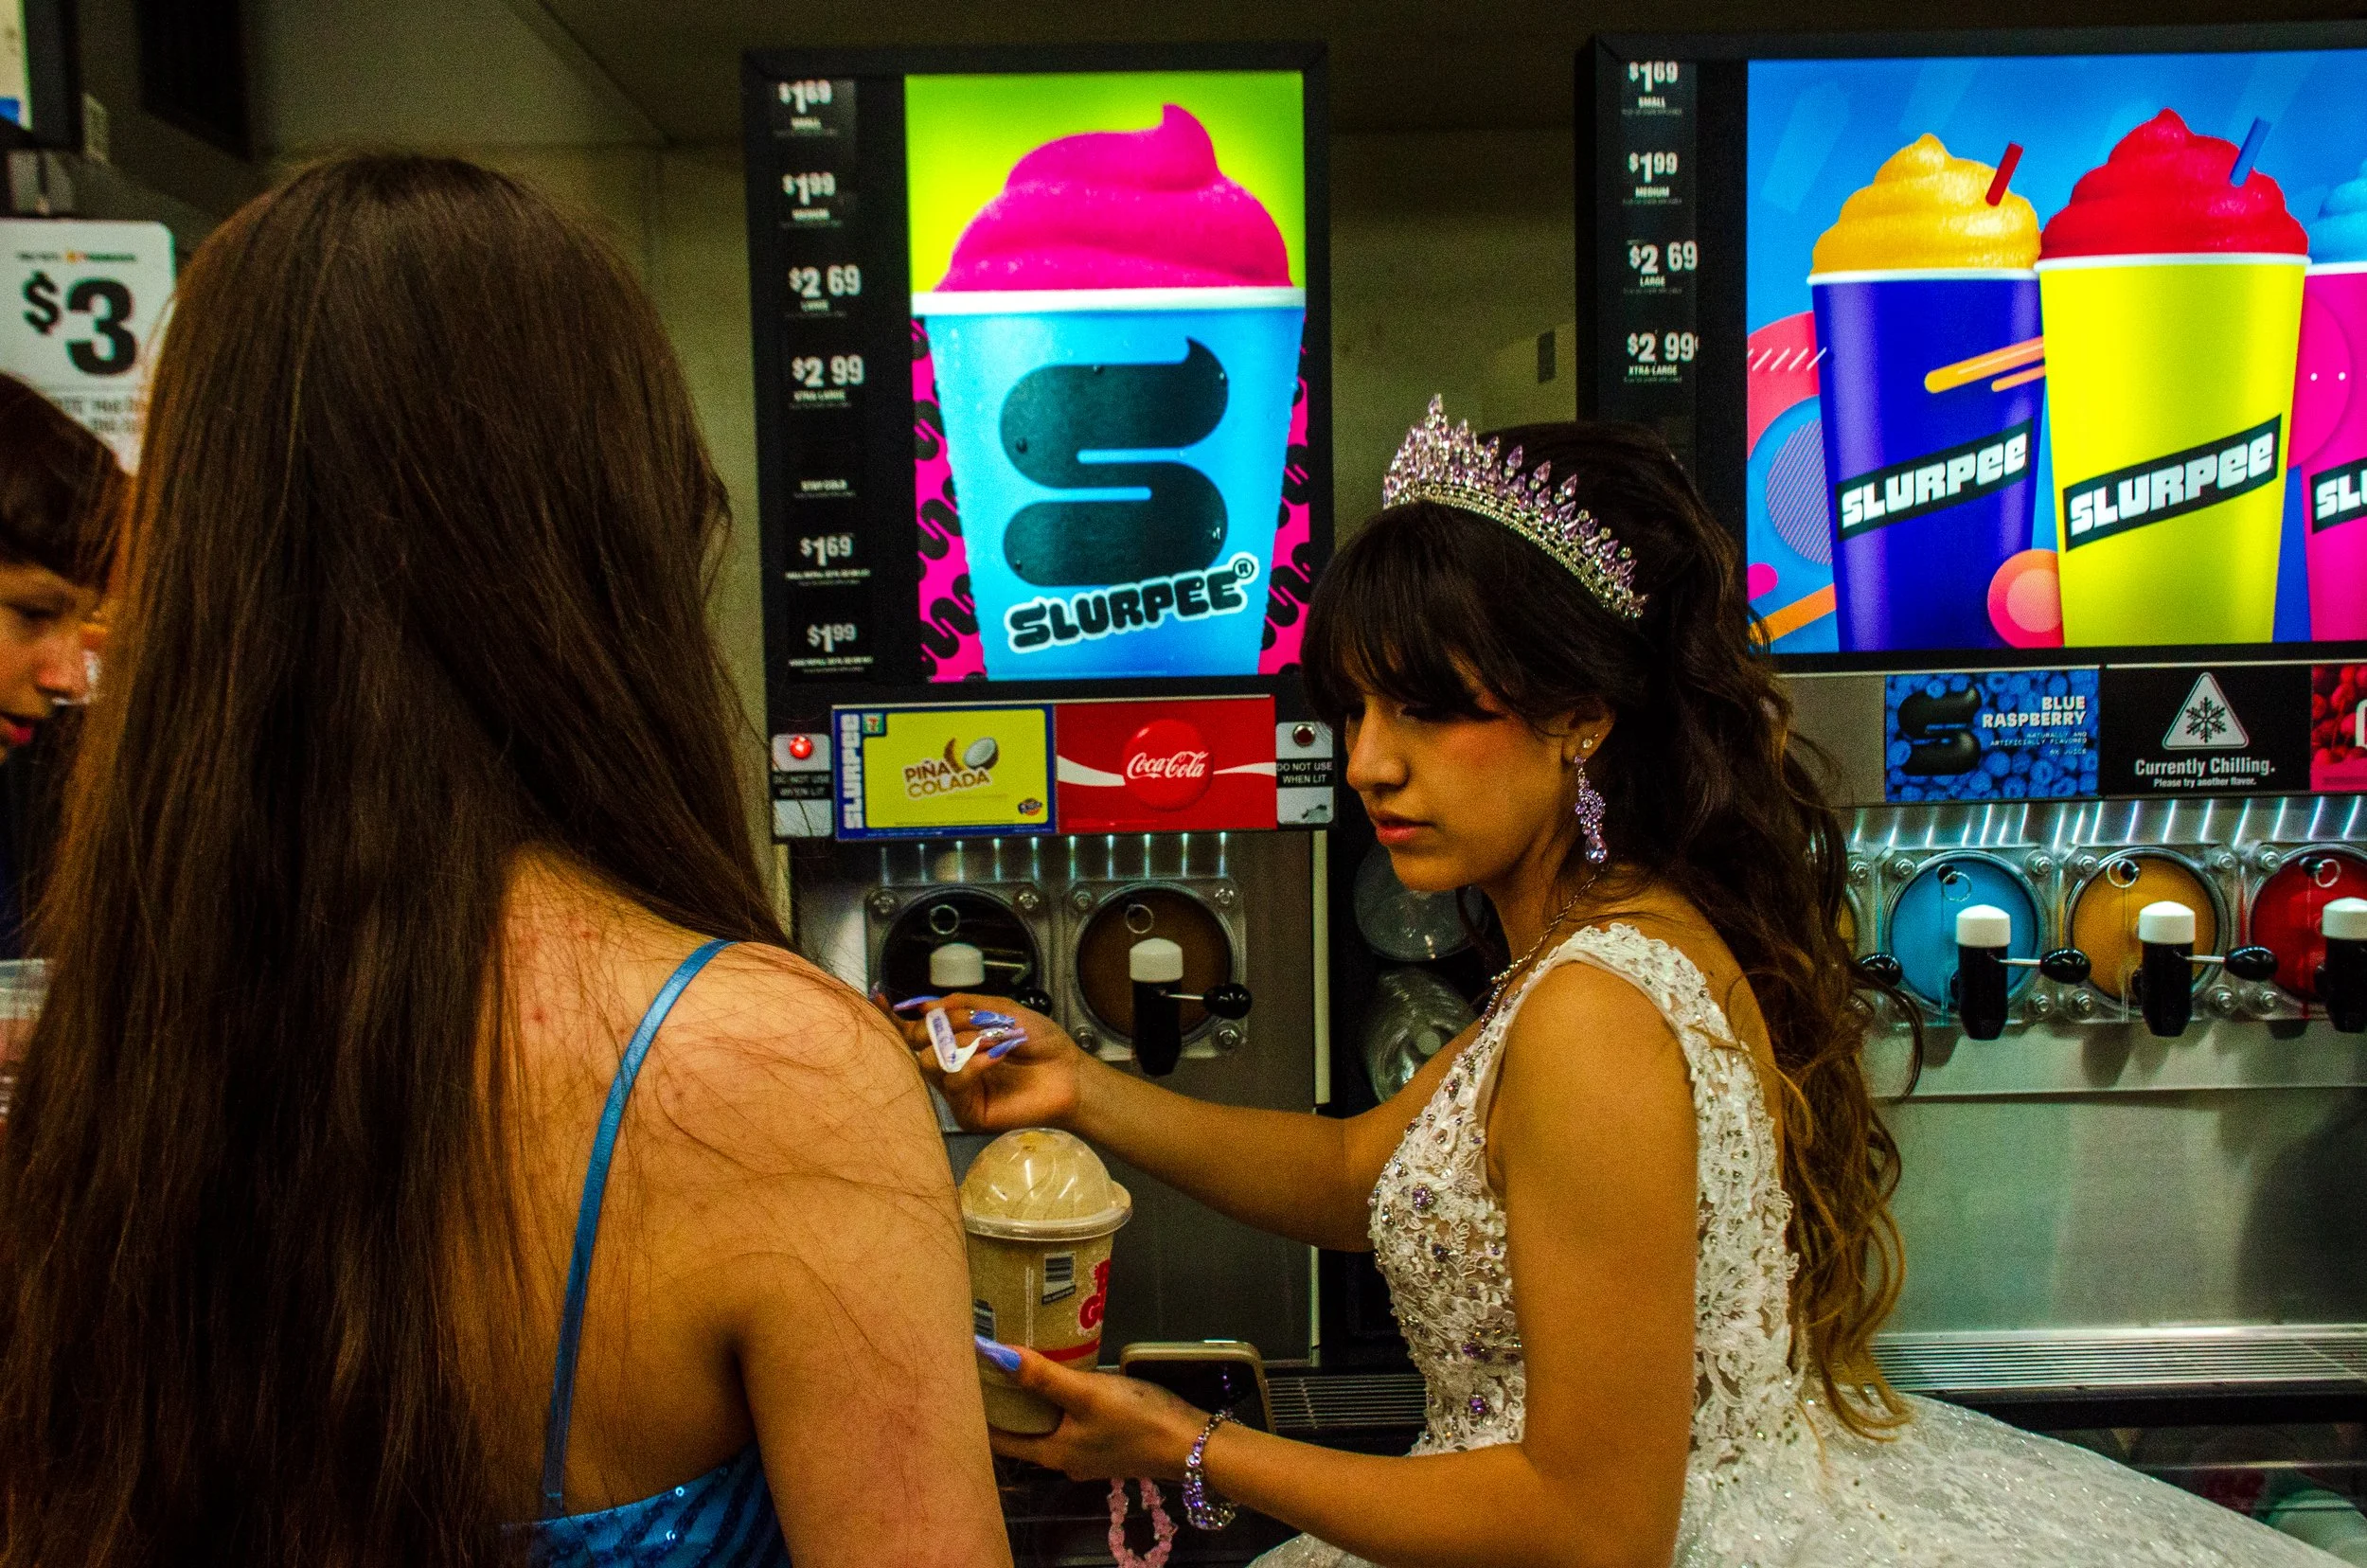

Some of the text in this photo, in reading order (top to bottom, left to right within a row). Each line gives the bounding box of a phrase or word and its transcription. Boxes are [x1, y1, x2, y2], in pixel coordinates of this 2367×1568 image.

[22, 270, 137, 377] $3
[2316, 469, 2367, 521] SL
[2041, 696, 2086, 711] BLUE
[1982, 710, 2087, 728] RASPBERRY
[904, 760, 951, 782] PIÑA
[1127, 750, 1209, 779] Coca-Cola
[1292, 761, 1311, 772] NOT
[1313, 760, 1333, 772] USE
[2135, 757, 2276, 777] Currently Chilling.
[908, 770, 989, 797] COLADA
[1282, 774, 1326, 784] WHEN LIT
[2153, 776, 2257, 789] Please try another flavor.
